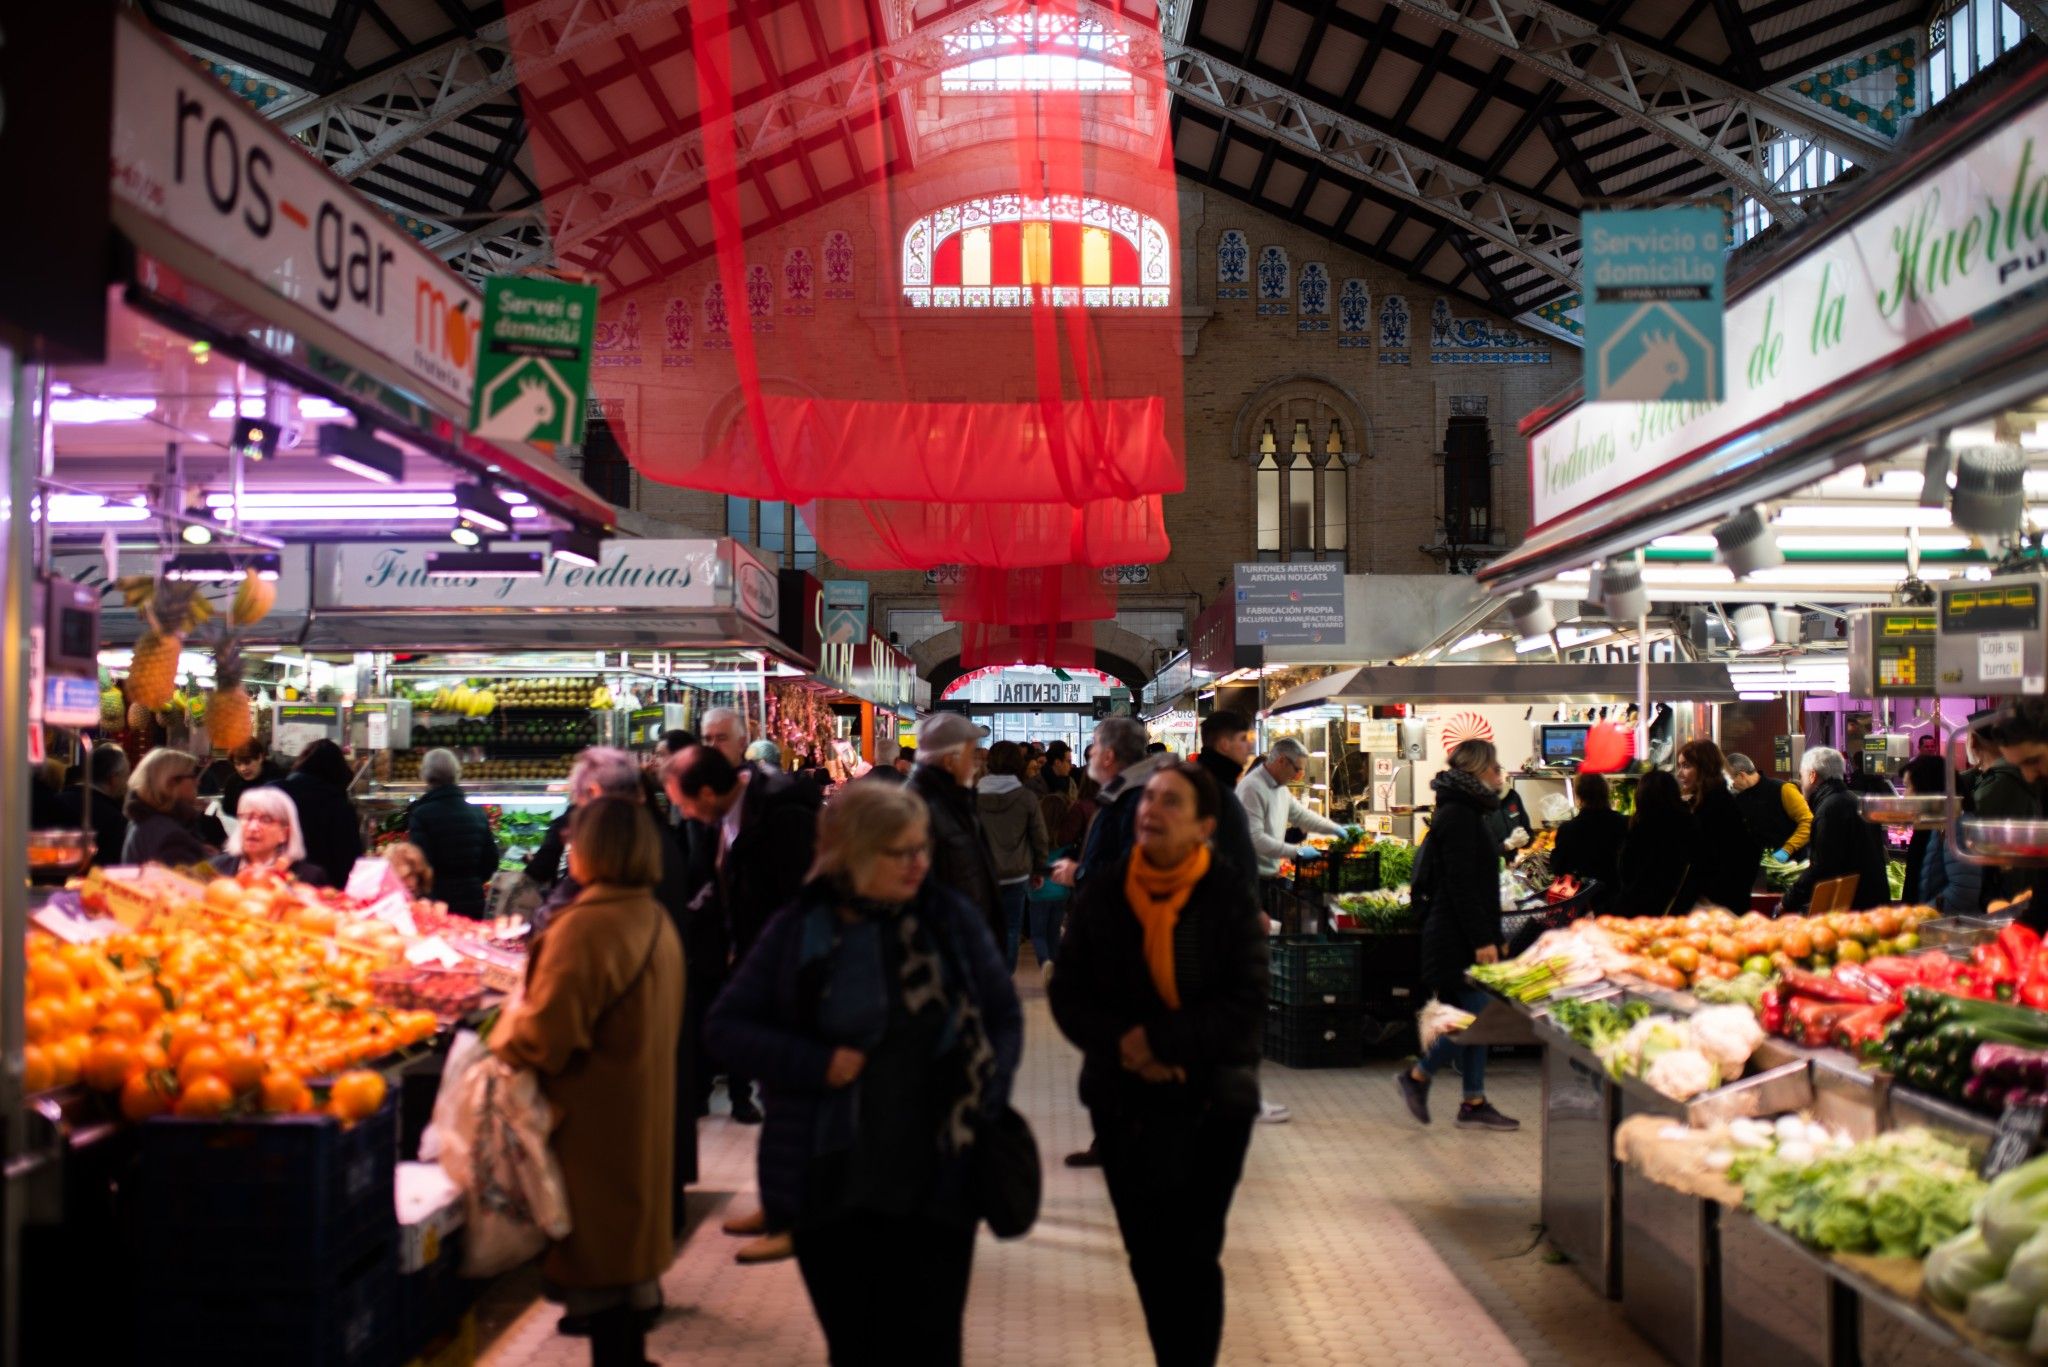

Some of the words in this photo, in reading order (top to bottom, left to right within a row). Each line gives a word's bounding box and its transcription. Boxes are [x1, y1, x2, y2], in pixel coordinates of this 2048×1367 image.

[174, 87, 395, 317] ros-gar
[1592, 226, 1696, 256] Servicio
[1702, 231, 1718, 252] a
[498, 289, 564, 318] Servei
[567, 301, 582, 320] a
[1747, 295, 1784, 390] de
[1811, 261, 1847, 356] la
[544, 553, 692, 588] Verduras
[1241, 565, 1286, 573] TURRONES
[1287, 564, 1337, 573] ARTESANOS
[1250, 574, 1287, 582] ARTISAN
[1288, 573, 1328, 581] NOUGATS
[1238, 616, 1284, 624] EXCLUSIVELY
[1285, 615, 1344, 623] MANUFACTURED
[1246, 606, 1302, 615] FABRICACIÓN
[1303, 606, 1334, 614] PROPIA
